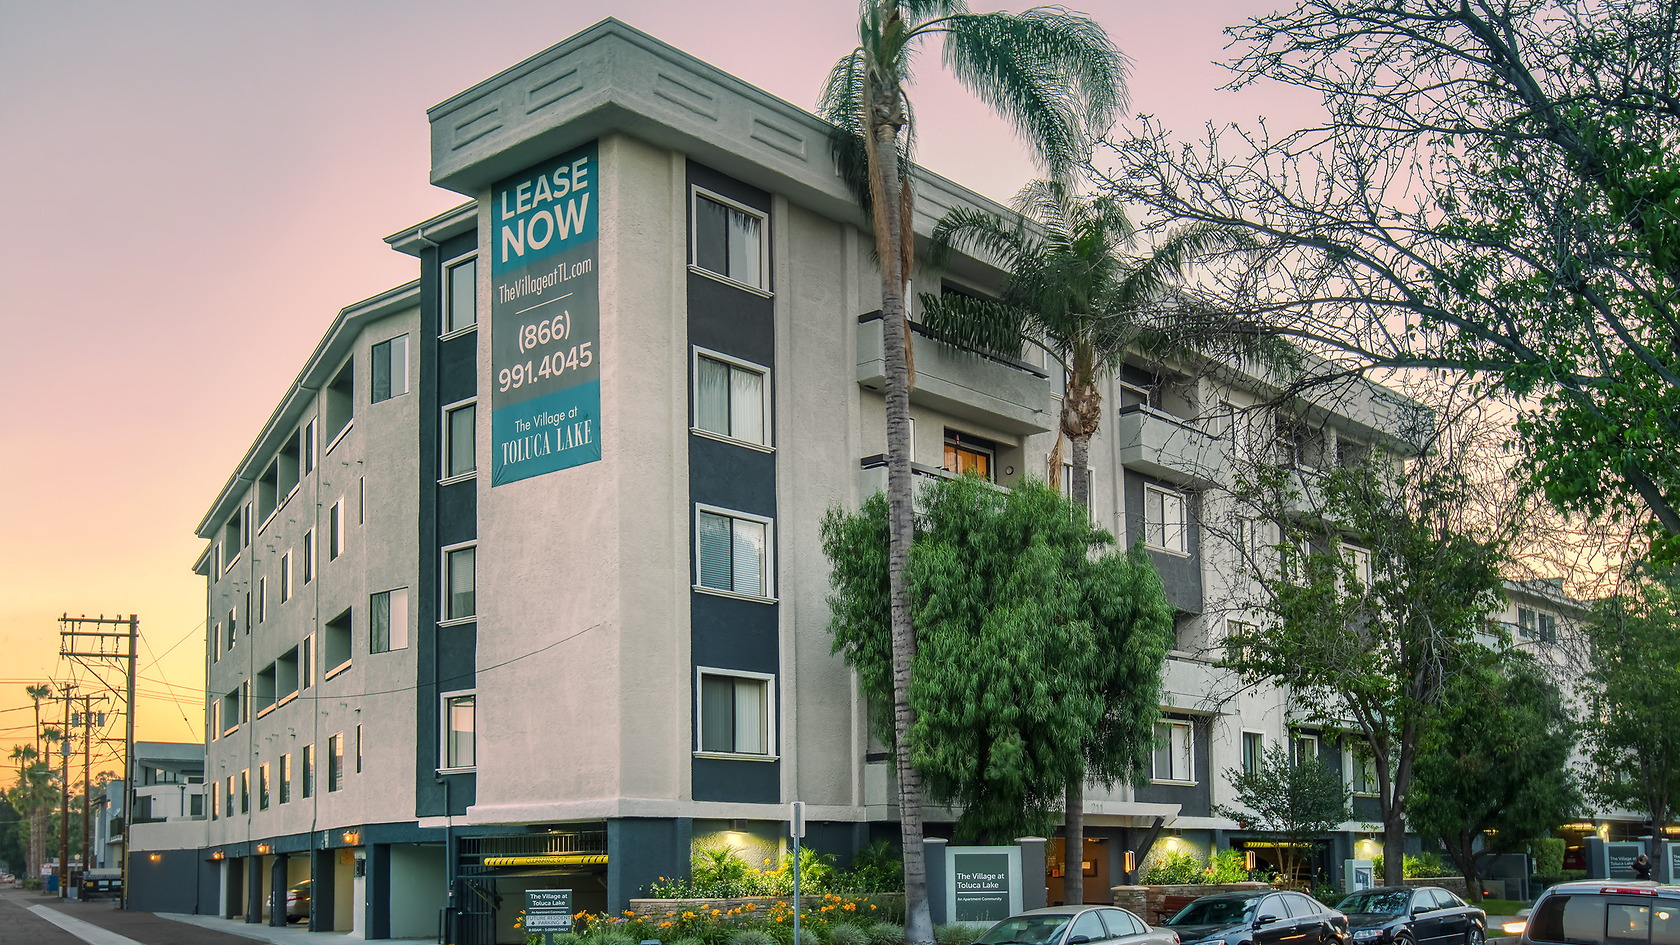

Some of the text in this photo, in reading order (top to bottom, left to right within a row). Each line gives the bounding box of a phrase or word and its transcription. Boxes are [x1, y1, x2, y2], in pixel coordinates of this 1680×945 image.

[502, 157, 588, 221] LEASE
[502, 192, 590, 263] NOW
[499, 258, 592, 304] TheVillageatTL.com
[519, 310, 571, 354] (866)
[499, 341, 593, 392] 991.4045
[502, 419, 593, 466] TOLUCA LAKE
[515, 406, 578, 433] The Village at
[957, 872, 971, 880] The
[971, 872, 996, 881] Village
[957, 881, 999, 889] Toluca Lake
